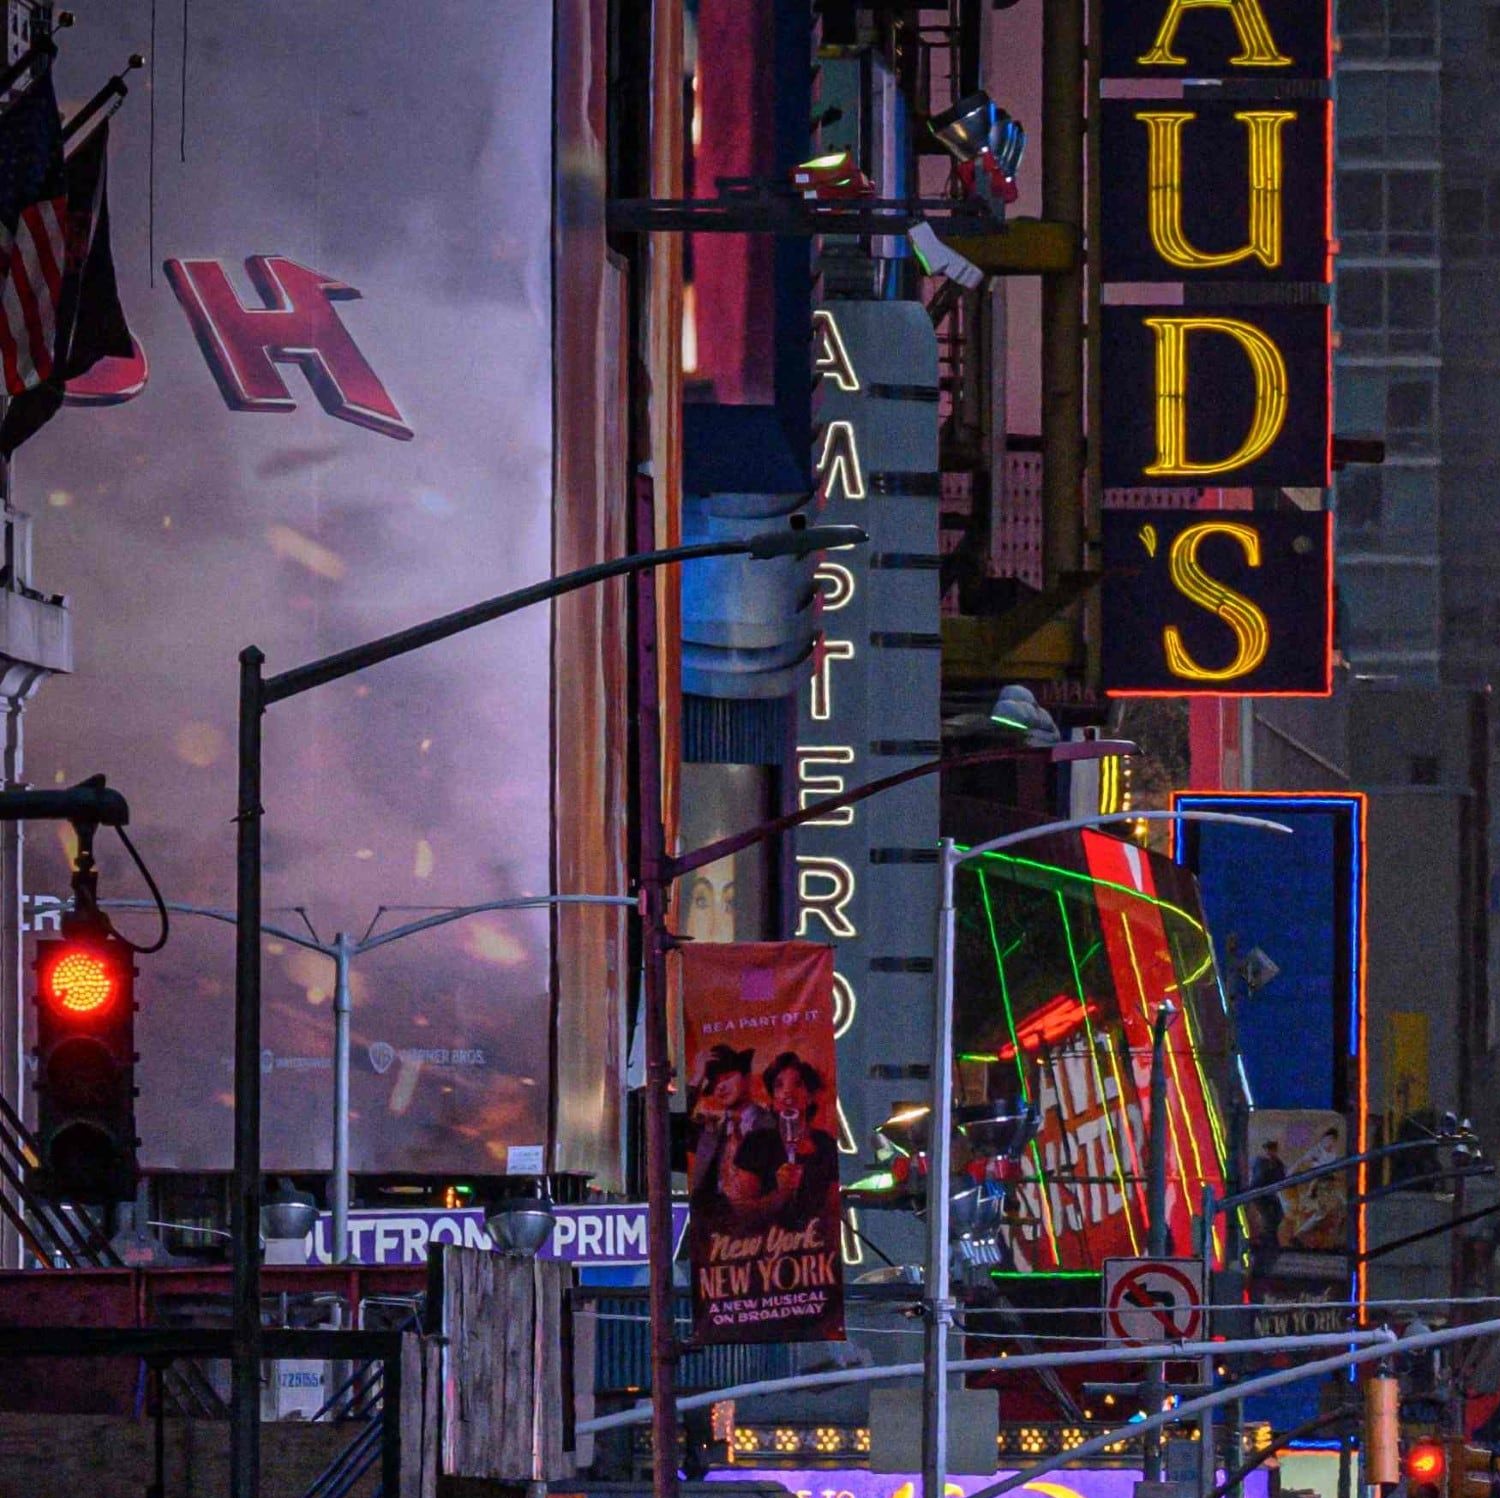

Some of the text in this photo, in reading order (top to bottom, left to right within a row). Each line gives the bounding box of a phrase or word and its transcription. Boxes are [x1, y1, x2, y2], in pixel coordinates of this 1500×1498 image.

[795, 310, 862, 1266] AMSTER
[739, 1013, 778, 1029] PART
[782, 1011, 801, 1025] OF
[551, 1213, 649, 1257] PRIM
[699, 1250, 837, 1301] NEW YORK
[709, 1290, 828, 1315] A NEW MUSICAL
[712, 1302, 826, 1327] ON BROADWAY
